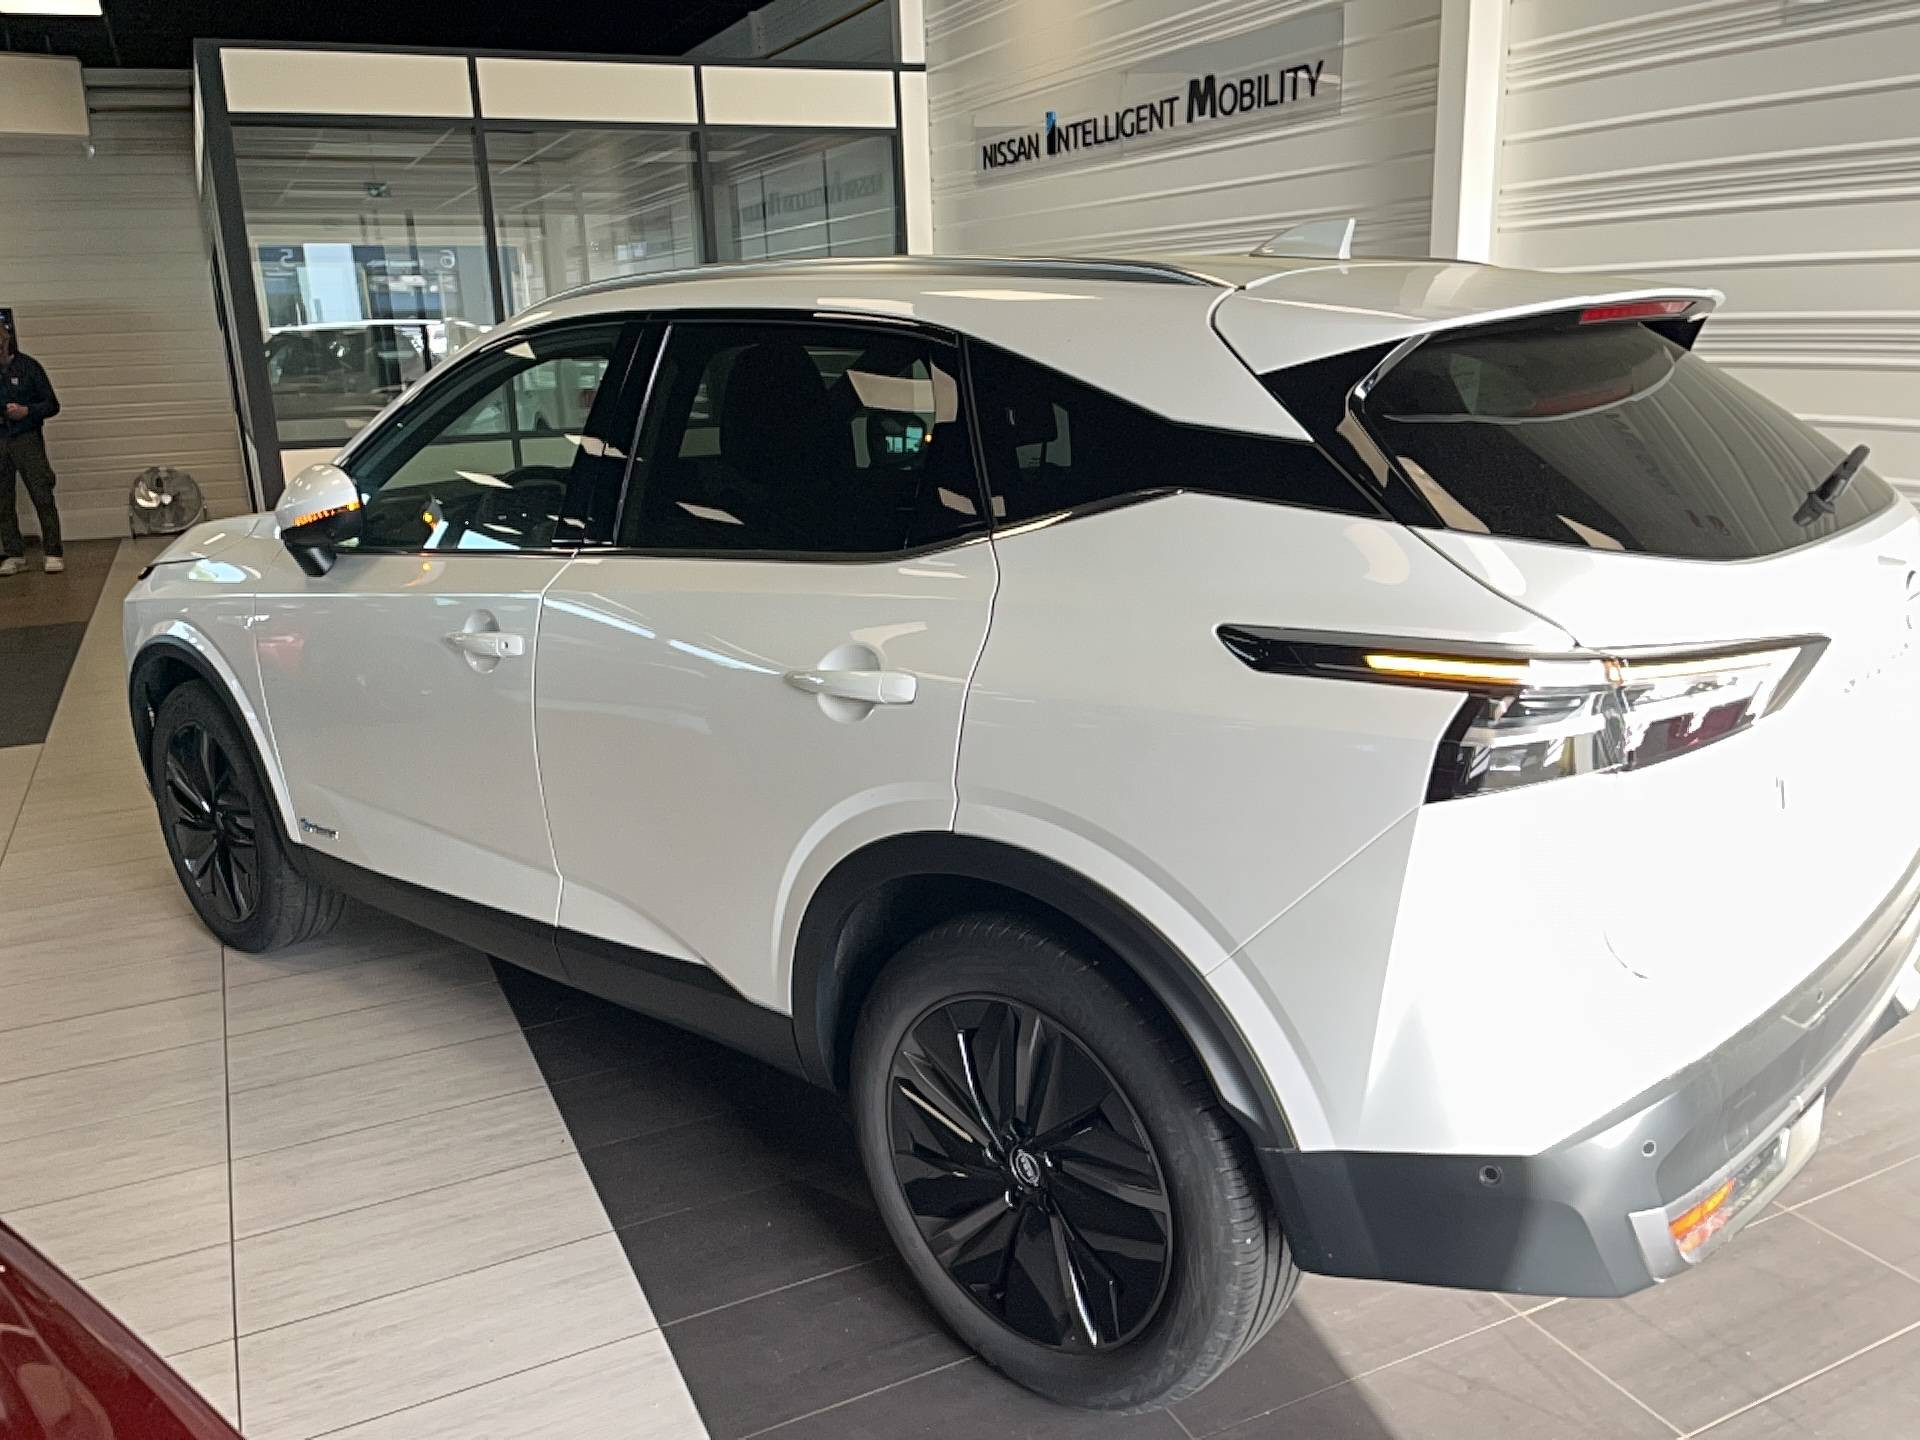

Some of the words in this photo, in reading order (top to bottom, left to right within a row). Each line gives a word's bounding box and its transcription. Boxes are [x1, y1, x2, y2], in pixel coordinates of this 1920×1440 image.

[982, 132, 1041, 170] NISSAN
[1045, 96, 1180, 156] INTELLIGENT
[1186, 60, 1325, 124] MOBILITY
